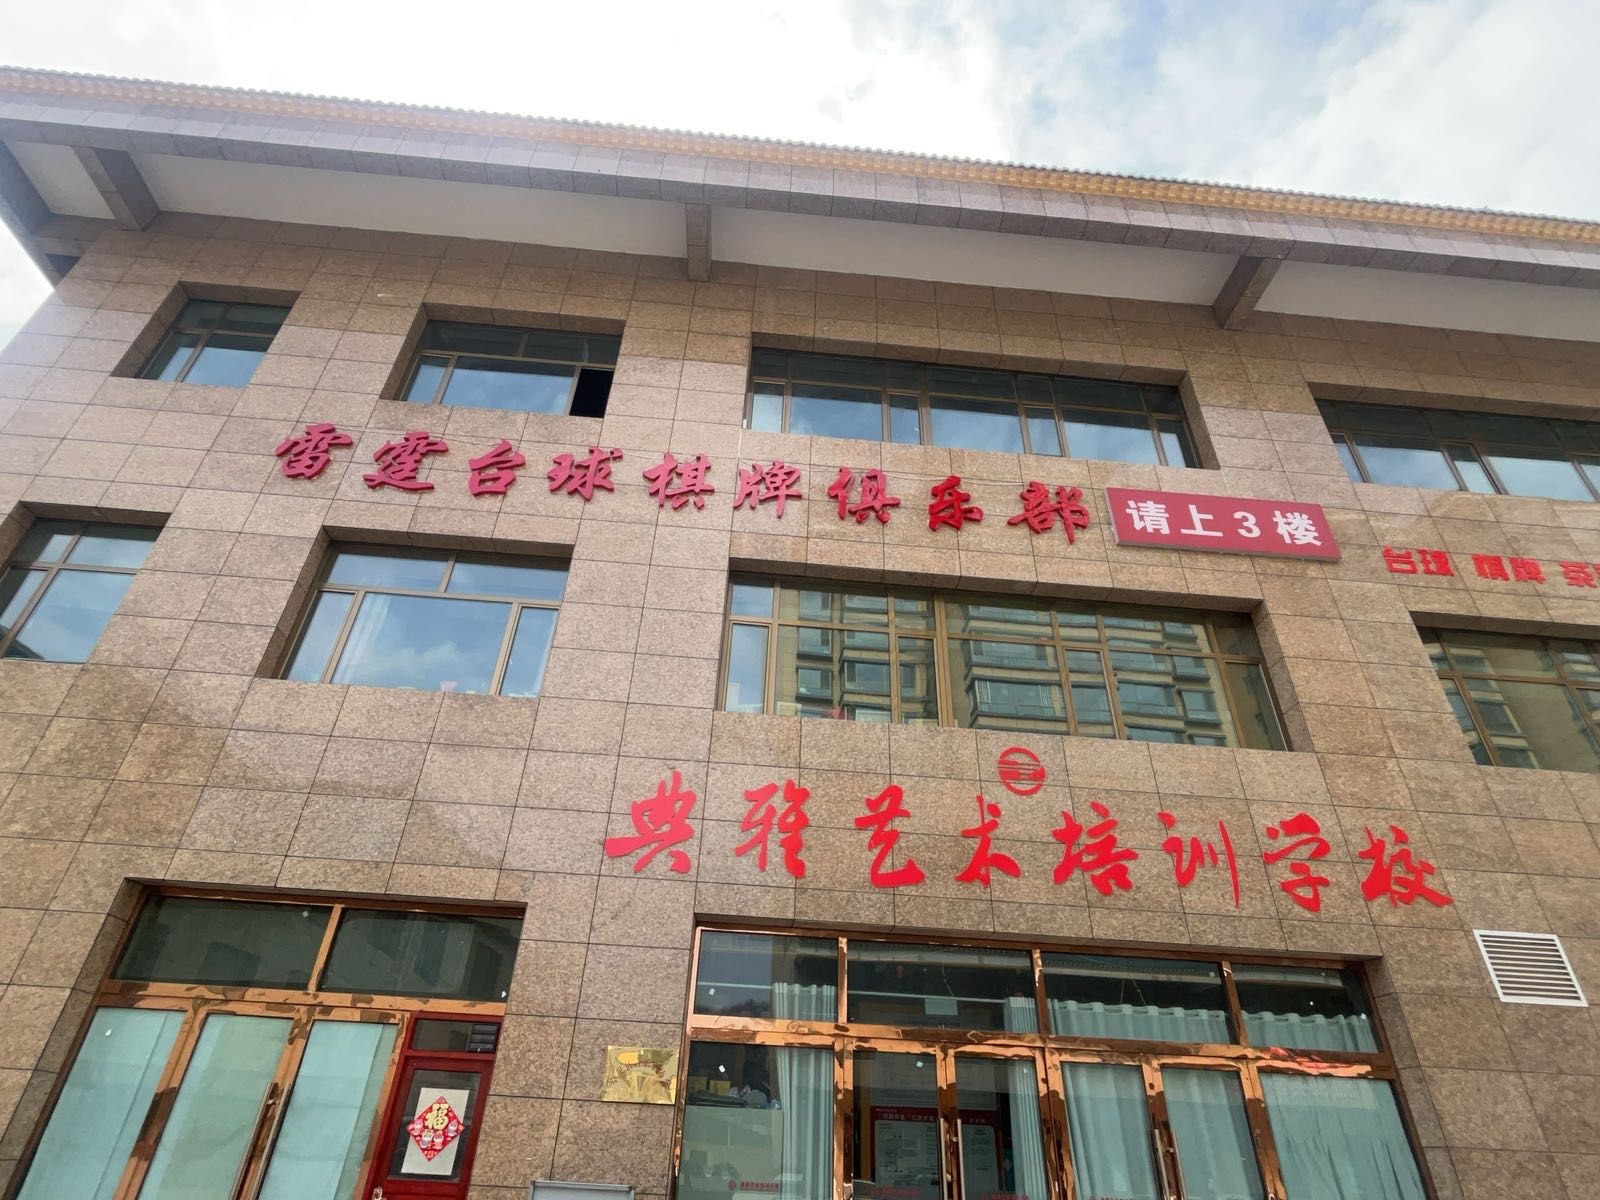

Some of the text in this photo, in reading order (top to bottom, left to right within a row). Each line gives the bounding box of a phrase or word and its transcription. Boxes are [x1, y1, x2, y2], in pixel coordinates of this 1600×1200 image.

[275, 422, 1091, 545] 雷霆台球棋牌俱乐部
[1125, 500, 1322, 547] 请上3楼
[604, 769, 1455, 913] 典雅艺术培训学校
[424, 1103, 449, 1131] 福
